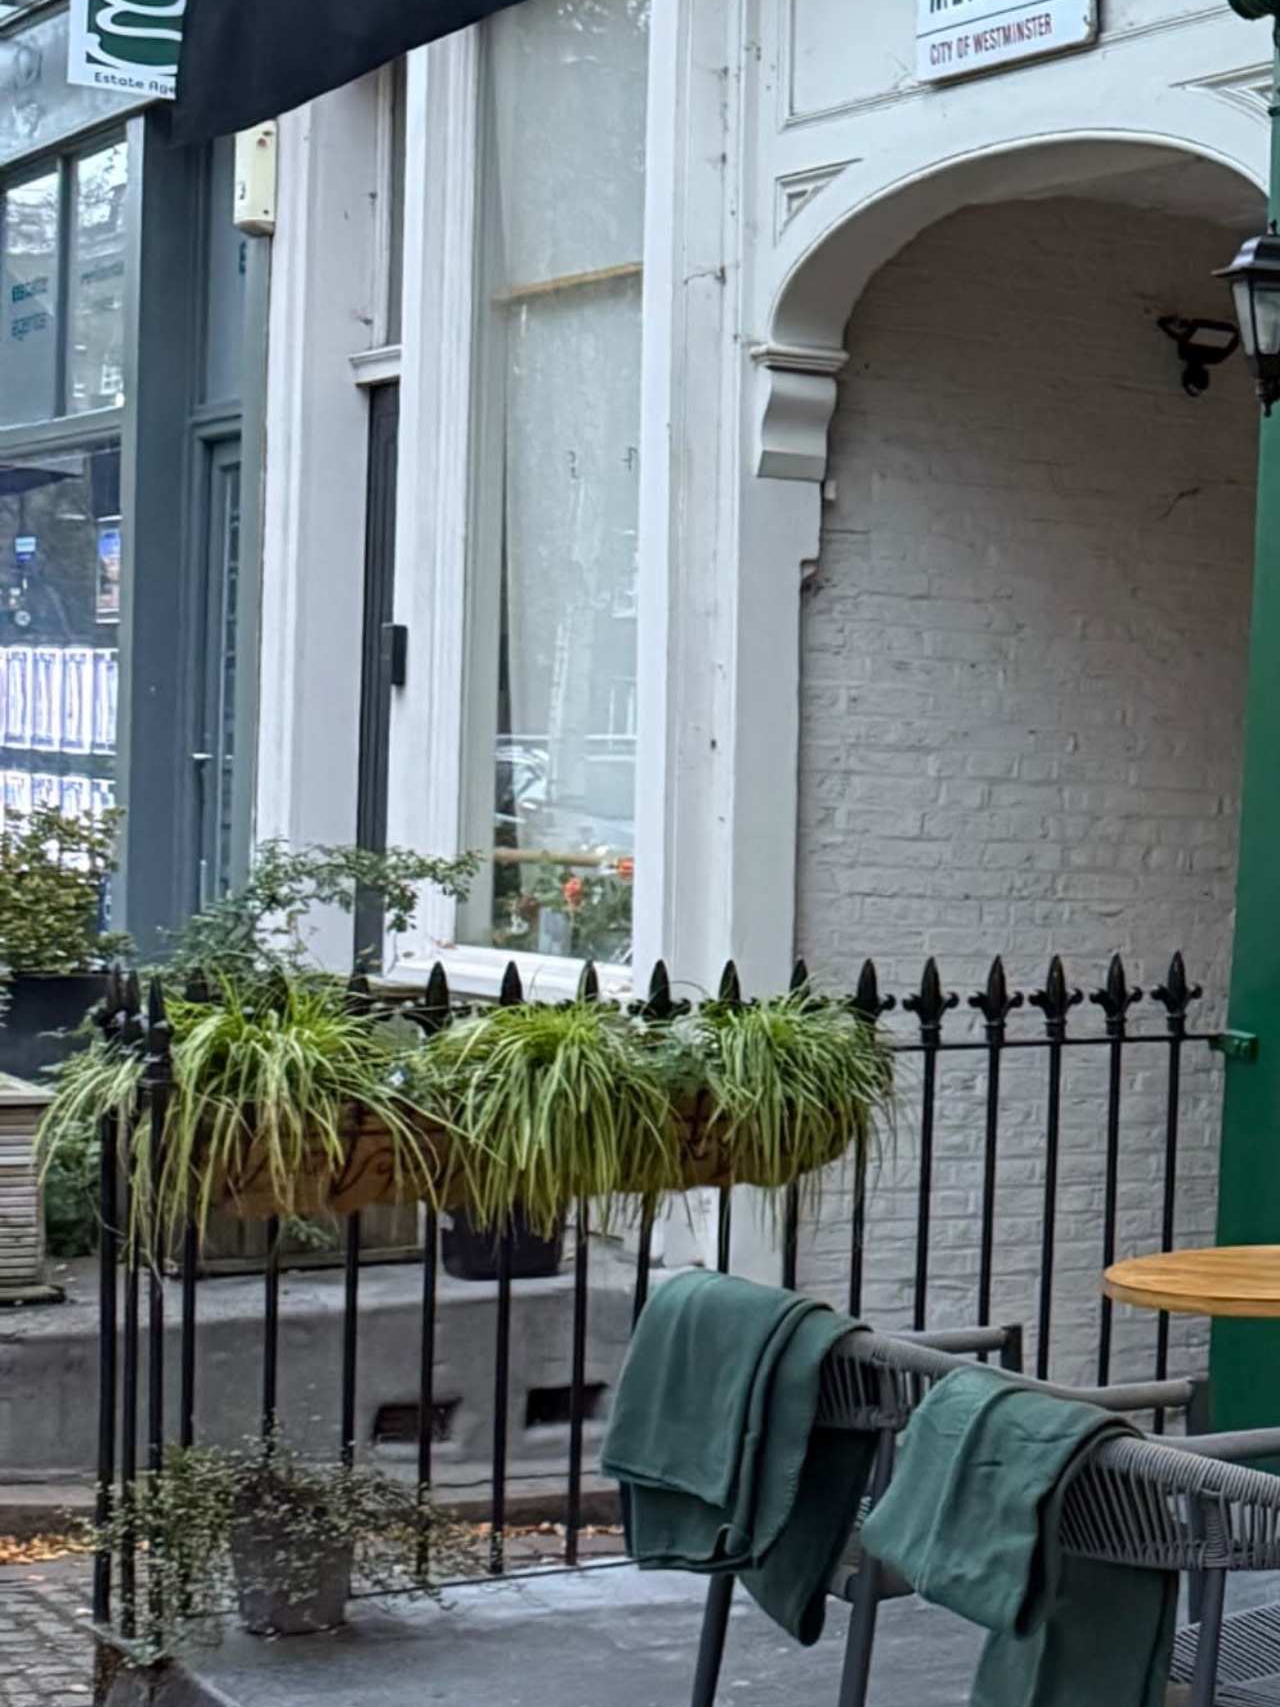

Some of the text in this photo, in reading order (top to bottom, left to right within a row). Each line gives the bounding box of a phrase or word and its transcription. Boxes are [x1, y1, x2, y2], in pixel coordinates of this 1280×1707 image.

[930, 12, 1053, 66] CITY OF WESTMINSTER
[94, 71, 145, 90] Estate
